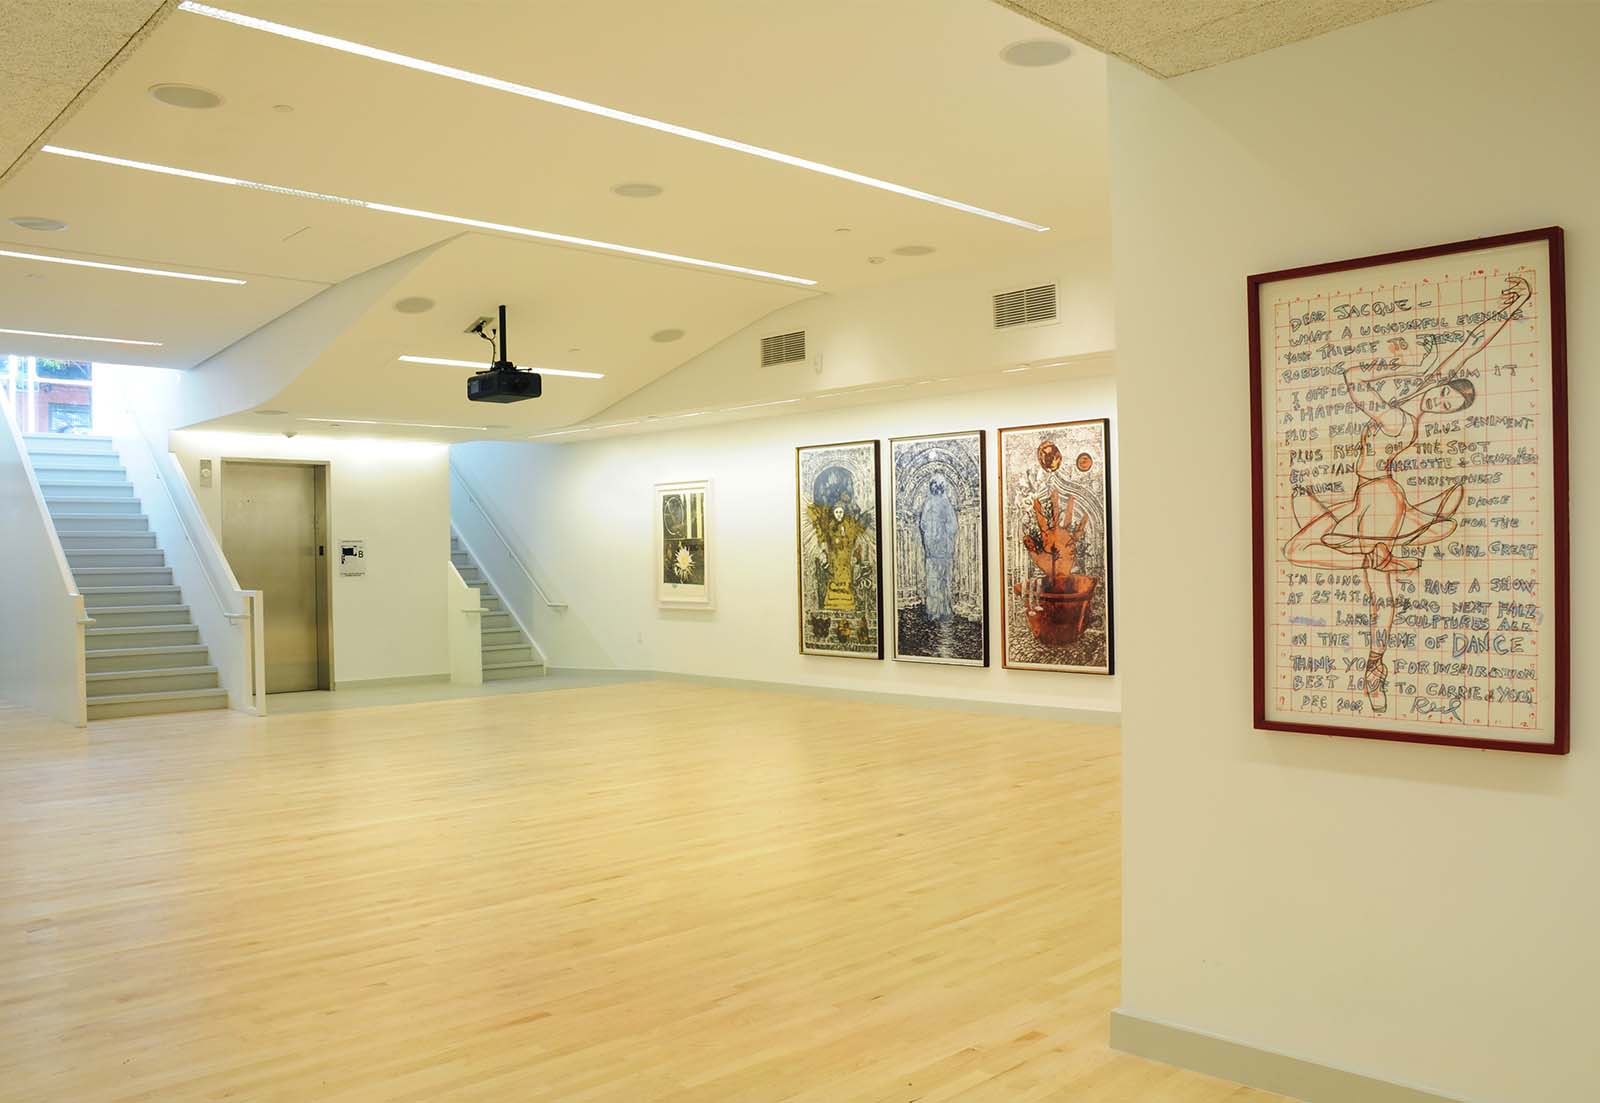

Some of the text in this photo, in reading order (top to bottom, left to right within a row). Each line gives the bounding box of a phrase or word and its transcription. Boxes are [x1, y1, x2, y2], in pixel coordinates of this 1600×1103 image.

[1289, 310, 1326, 332] DEAR
[1333, 299, 1412, 320] JACQUE
[1288, 329, 1332, 347] WHAT
[1341, 326, 1353, 339] A
[1387, 336, 1409, 351] TO
[1360, 358, 1400, 373] WAS
[1494, 364, 1518, 376] IT
[1283, 412, 1294, 424] A
[1285, 428, 1319, 446] PLUS
[1424, 420, 1461, 437] PLUS
[1289, 449, 1323, 467] PLUS
[1415, 440, 1443, 455] THE
[1447, 440, 1491, 455] SPOT
[1490, 515, 1520, 529] THE
[1447, 541, 1486, 558] GIRL
[1315, 573, 1361, 586] GOING
[1396, 579, 1416, 594] TO
[1424, 578, 1460, 595] HAVE
[1468, 578, 1481, 593] A
[1490, 576, 1536, 593] SHOW
[1451, 600, 1492, 615] NEXT
[1393, 609, 1490, 631] SCULPTURES
[1291, 633, 1307, 646] ON
[1317, 632, 1350, 647] THE
[1424, 634, 1448, 649] OF
[1452, 632, 1525, 657] DANCE
[1291, 655, 1337, 674] THANK
[1393, 659, 1430, 675] FOR
[1293, 675, 1338, 691] BEST
[1395, 681, 1417, 695] TO
